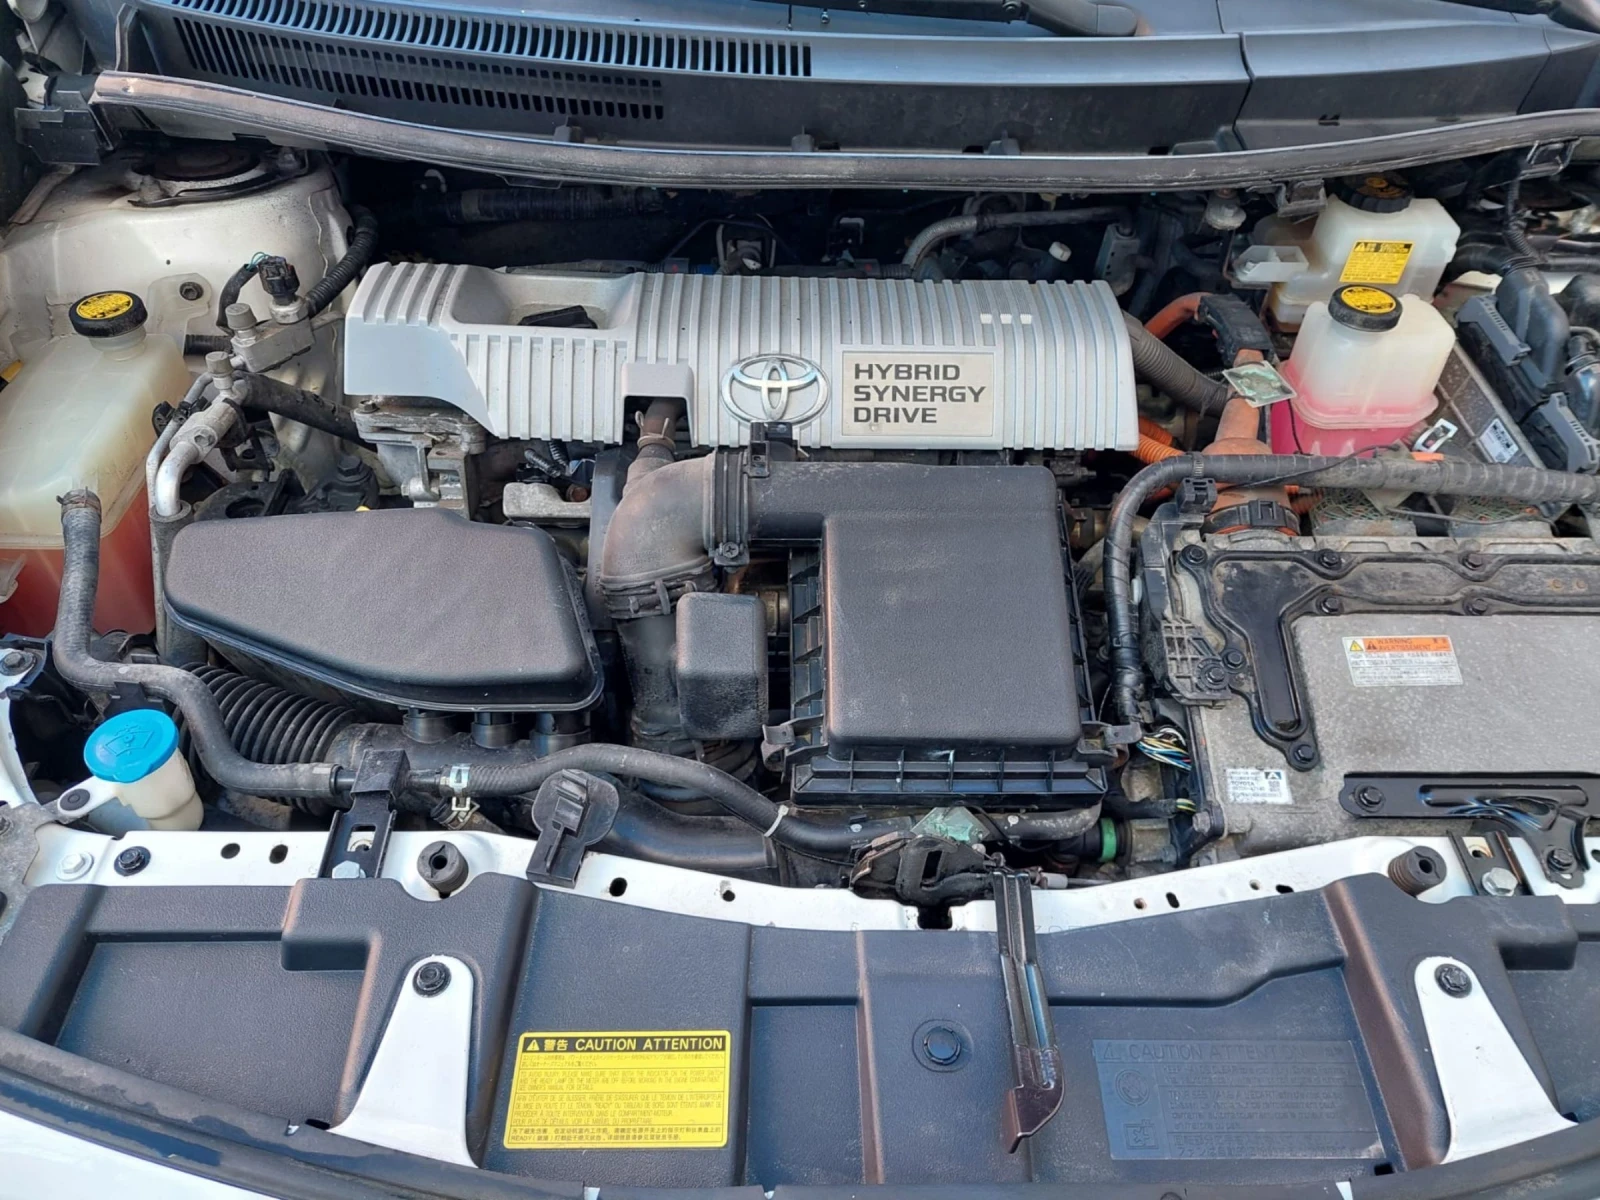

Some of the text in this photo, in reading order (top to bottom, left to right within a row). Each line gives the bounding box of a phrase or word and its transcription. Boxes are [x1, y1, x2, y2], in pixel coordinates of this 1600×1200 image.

[854, 363, 960, 380] HYBRID
[854, 385, 986, 402] SYNERGY
[853, 407, 937, 423] DRIVE
[544, 1039, 569, 1051] 警告
[575, 1037, 723, 1051] CAUTION ATTENTION
[1128, 1044, 1201, 1060] CAUTION
